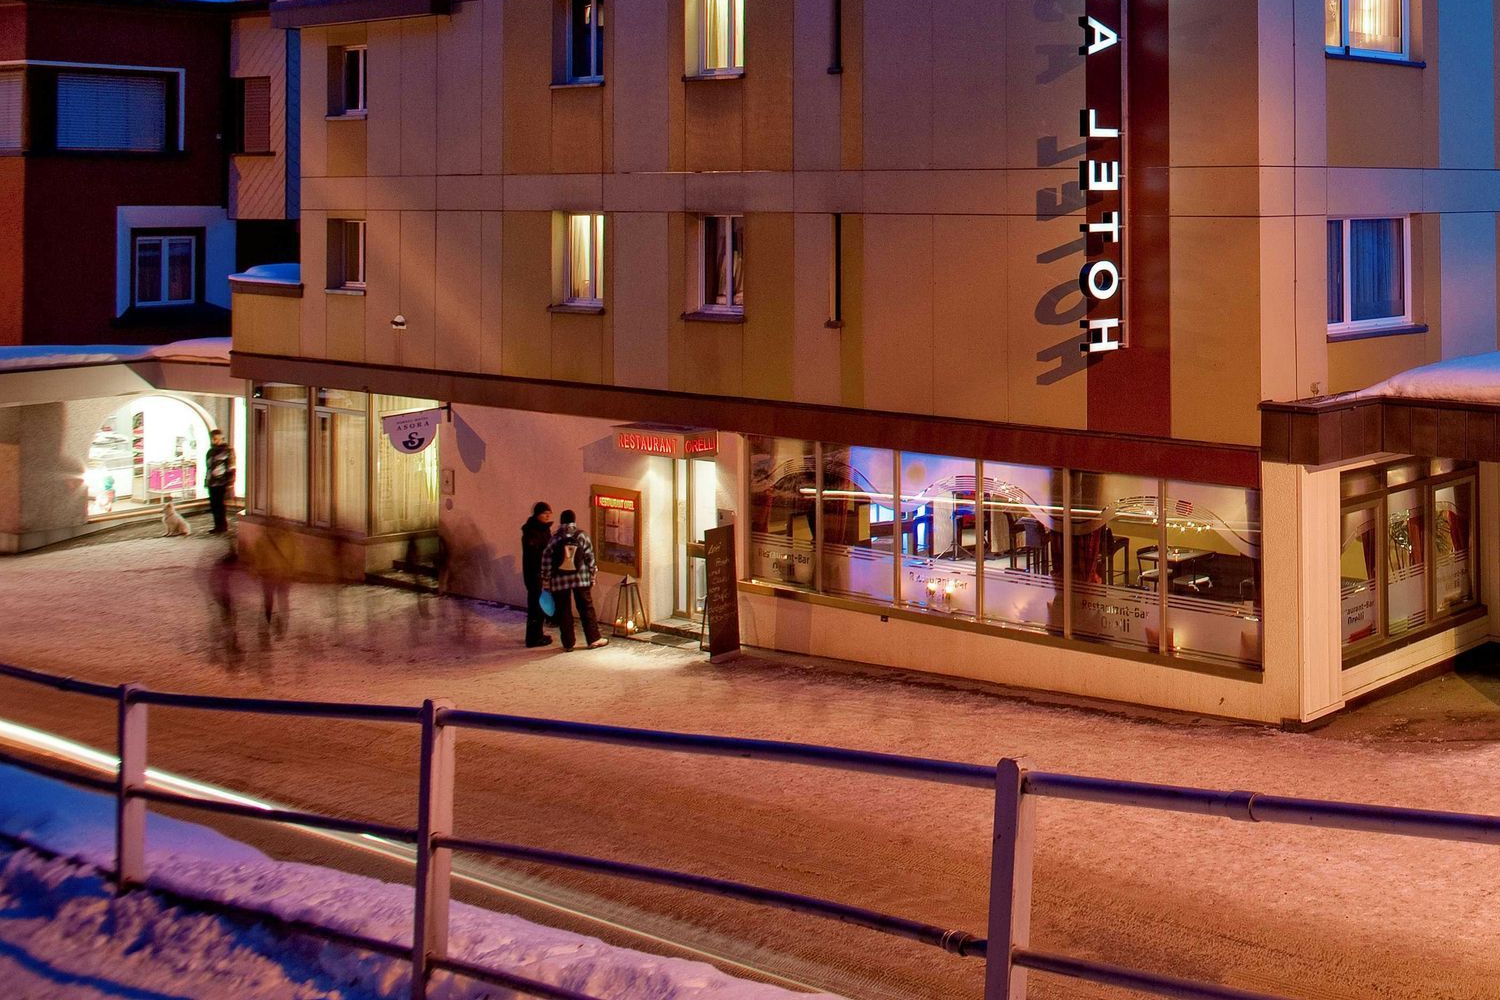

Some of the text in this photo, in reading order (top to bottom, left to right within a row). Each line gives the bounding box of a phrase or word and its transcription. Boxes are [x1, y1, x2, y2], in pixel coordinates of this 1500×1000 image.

[396, 420, 430, 431] ASORA
[618, 432, 716, 455] RESTAURANT ORELLI
